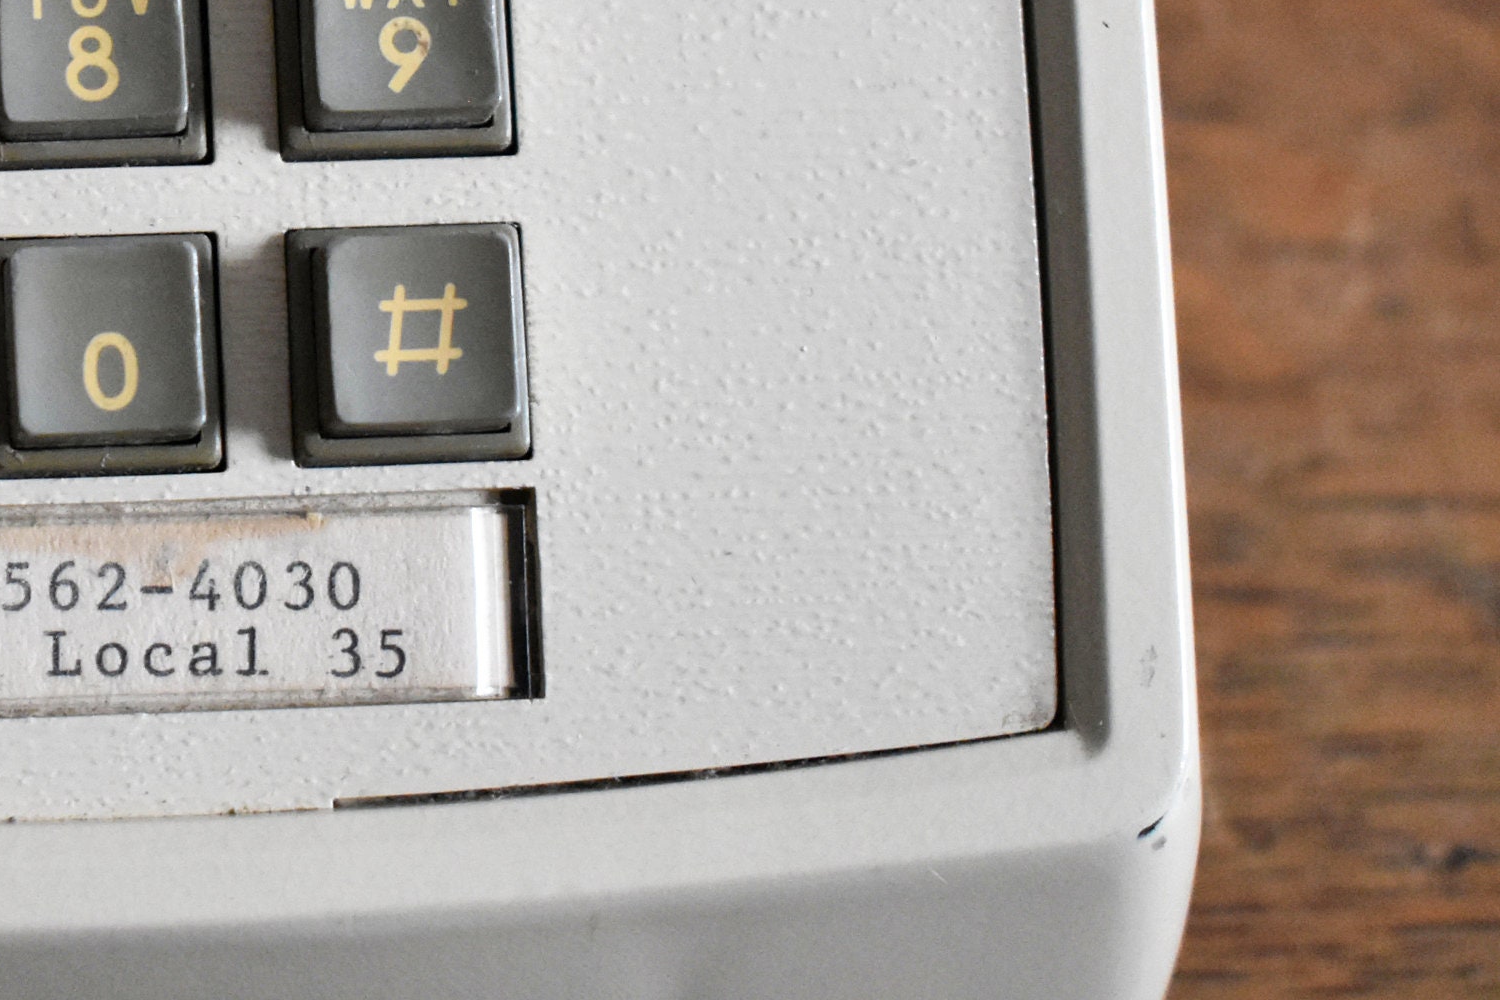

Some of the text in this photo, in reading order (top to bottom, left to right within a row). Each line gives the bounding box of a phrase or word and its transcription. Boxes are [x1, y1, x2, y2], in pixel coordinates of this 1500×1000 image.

[66, 25, 120, 102] 8
[380, 18, 430, 92] 9
[84, 333, 139, 411] 0
[4, 561, 360, 611] 562-4030
[47, 627, 405, 678] Local 35
